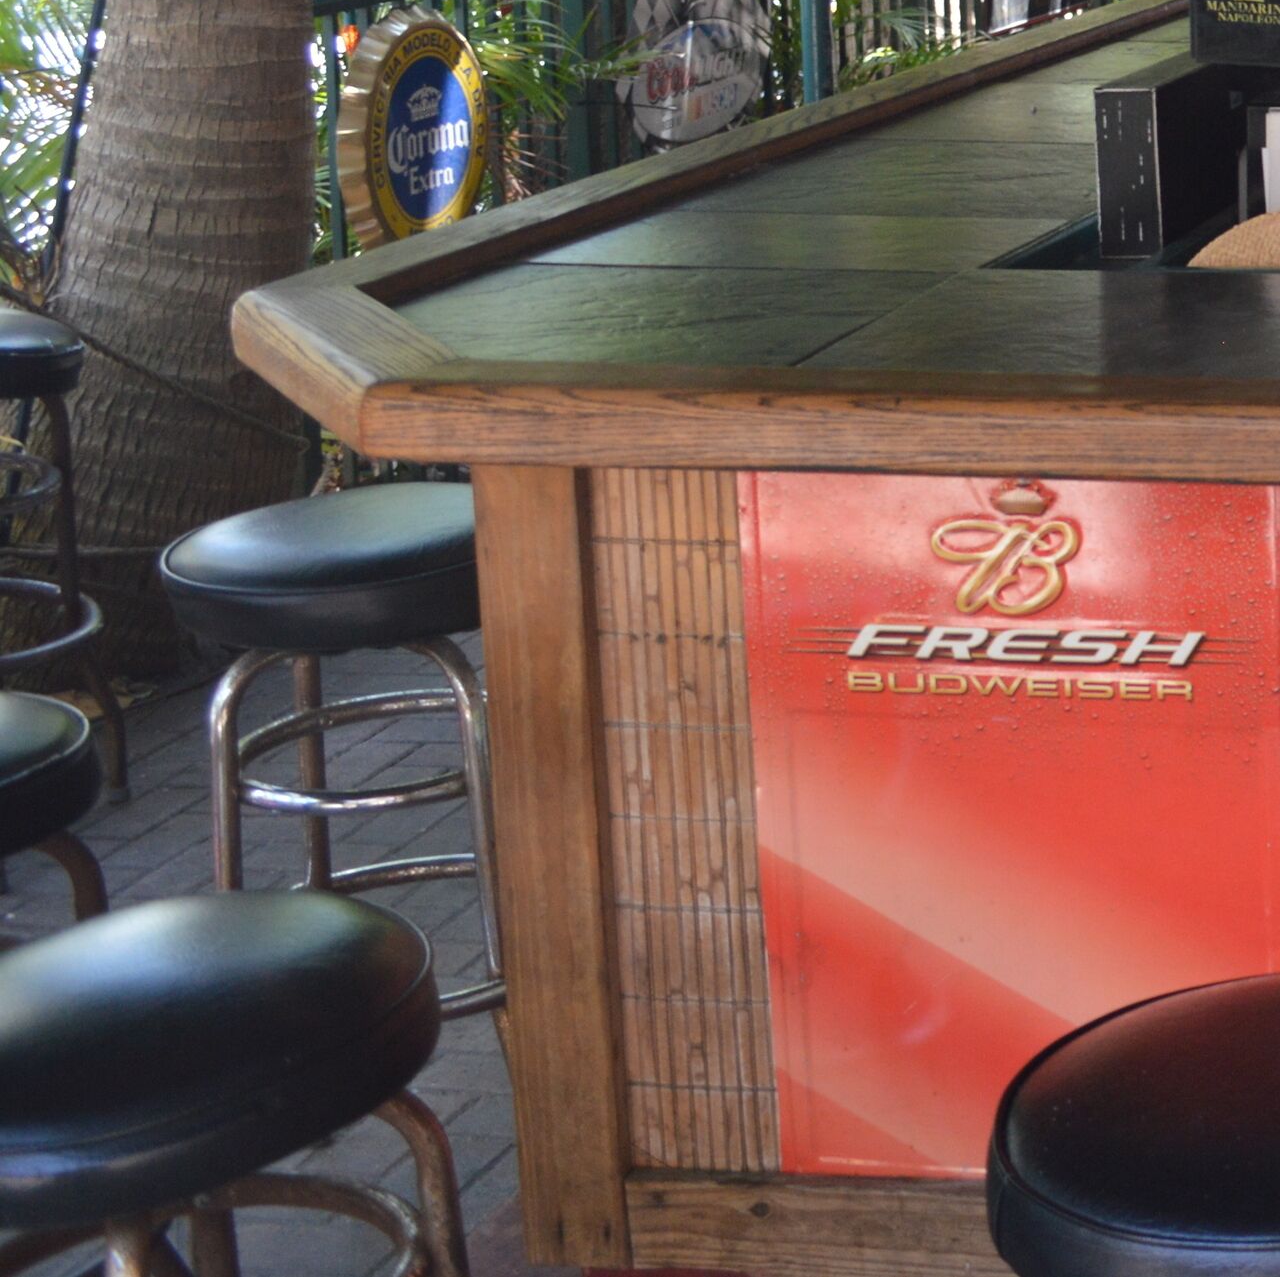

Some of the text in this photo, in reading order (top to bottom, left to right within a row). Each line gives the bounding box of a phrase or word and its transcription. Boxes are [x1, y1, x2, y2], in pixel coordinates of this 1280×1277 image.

[387, 118, 470, 175] Corona
[405, 165, 454, 196] Extra
[846, 623, 1206, 667] FRESH
[847, 671, 1194, 701] BUDWEISER
